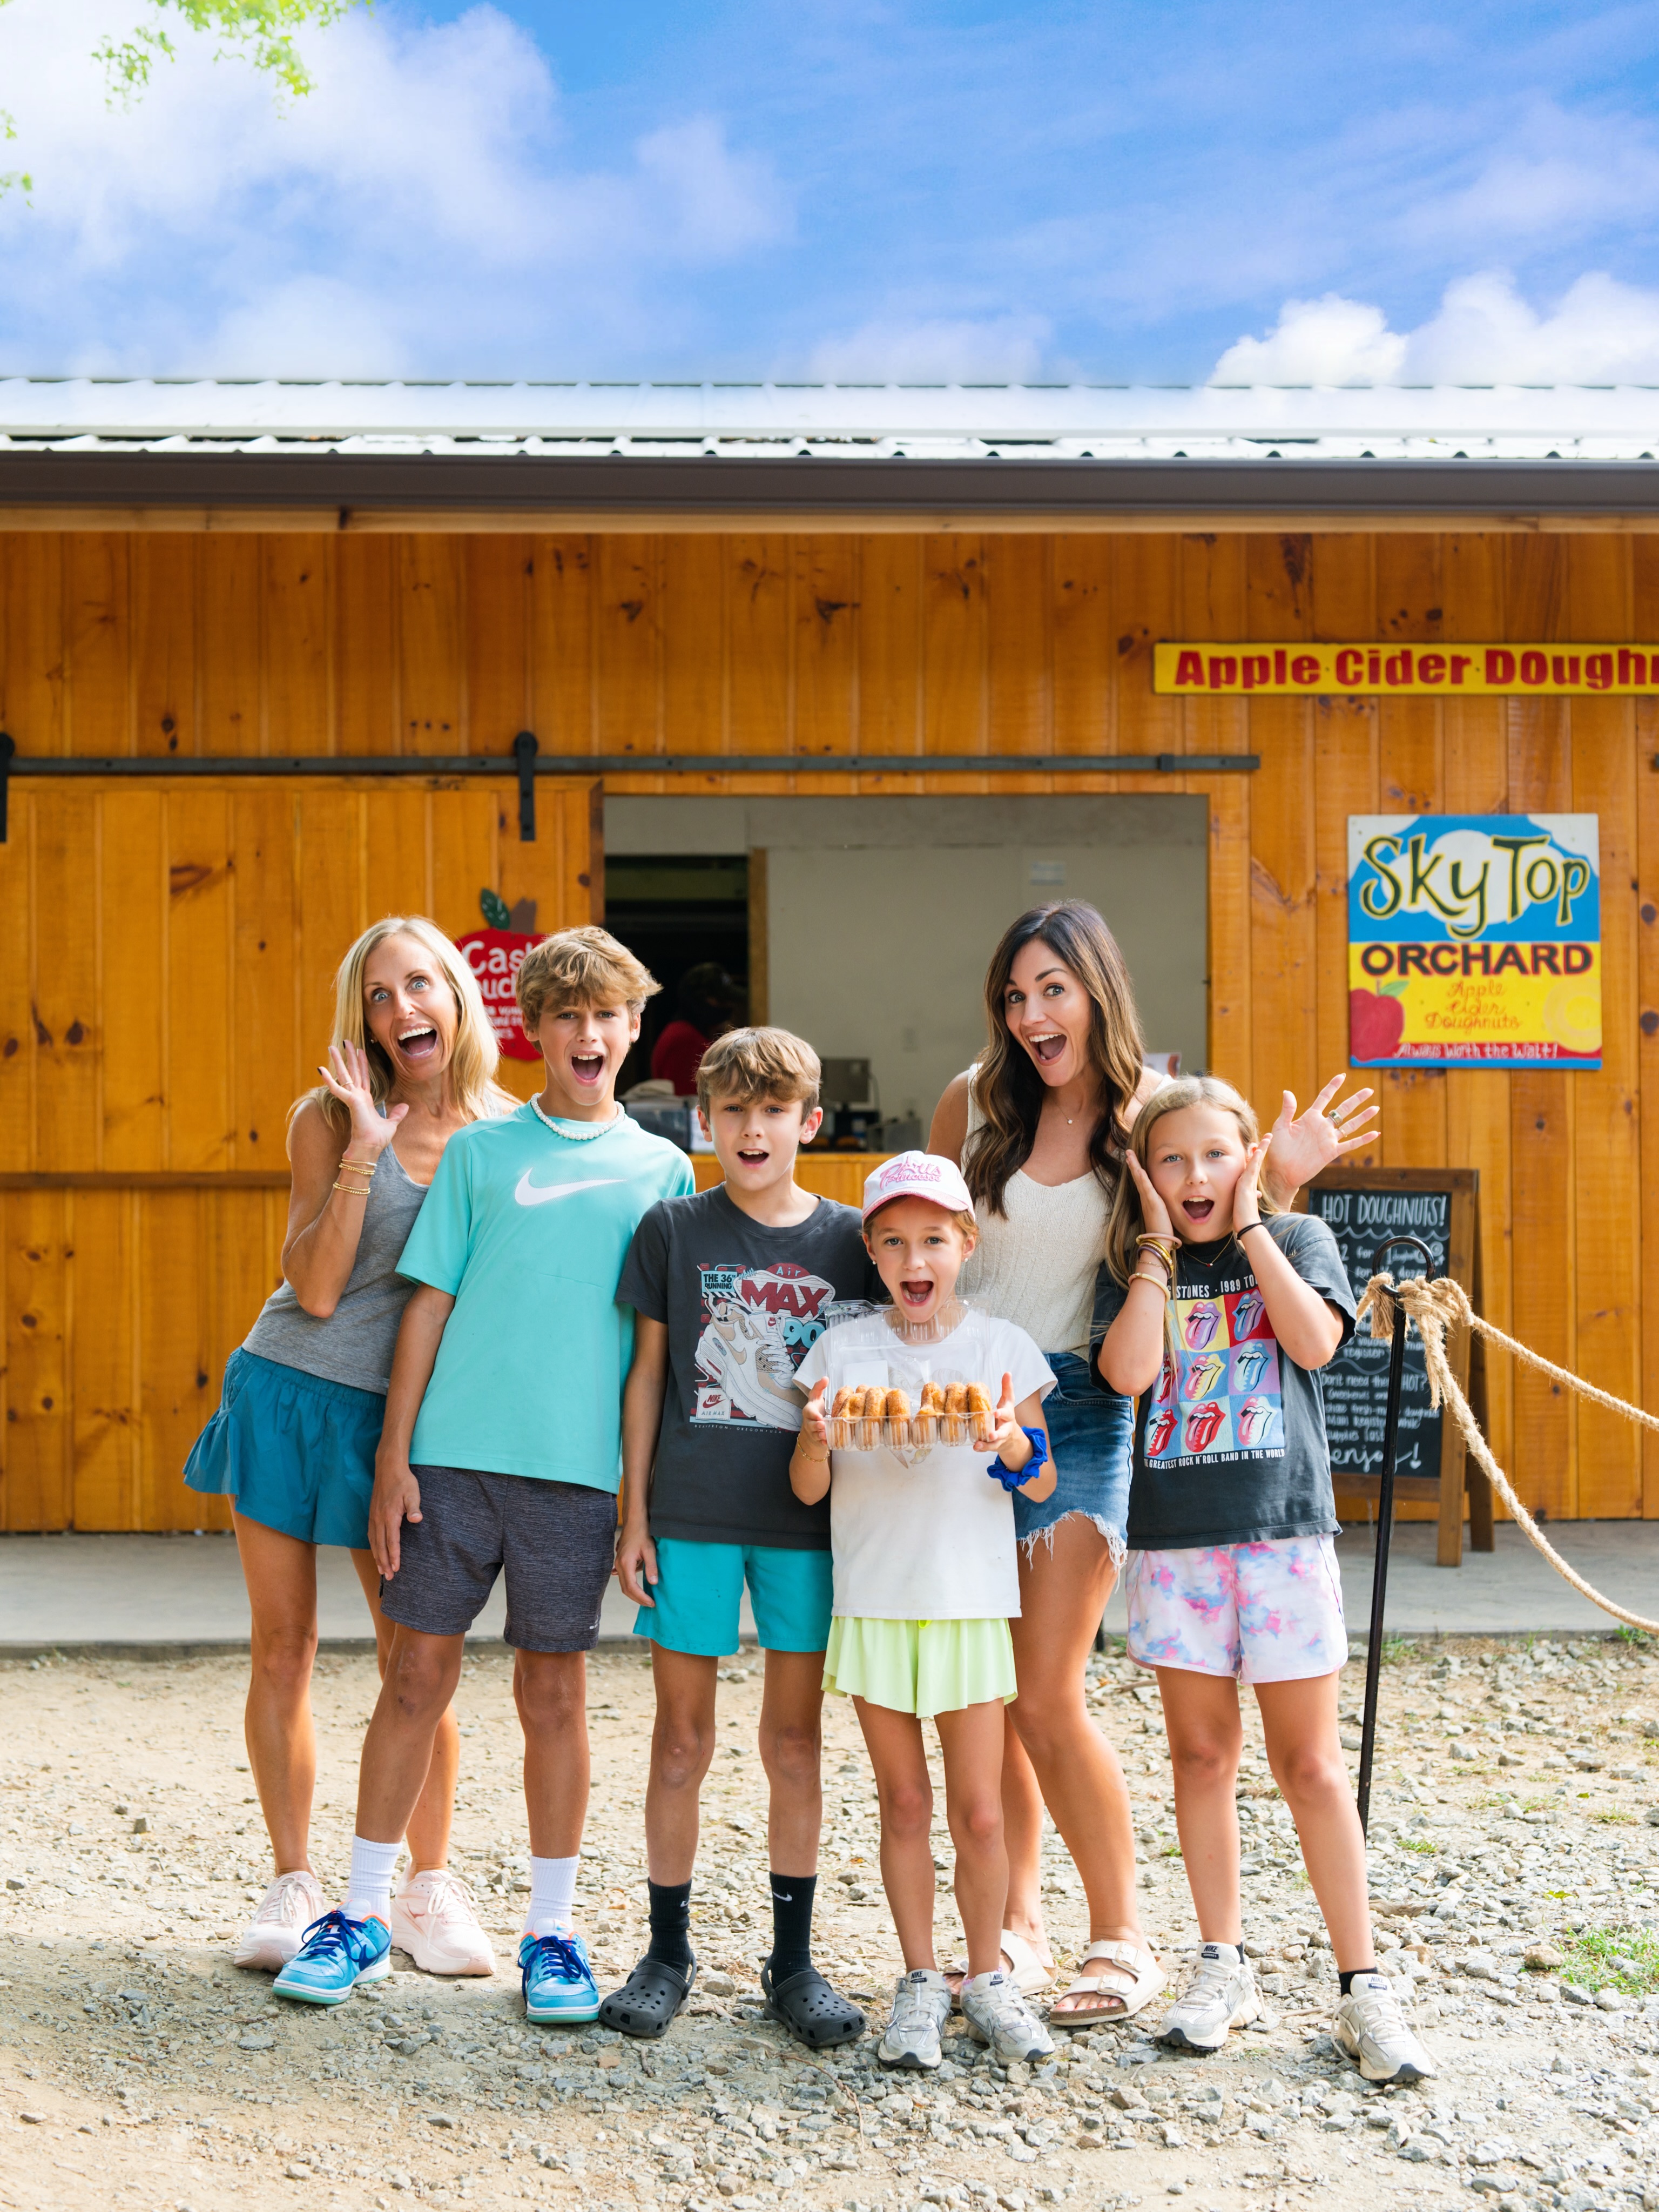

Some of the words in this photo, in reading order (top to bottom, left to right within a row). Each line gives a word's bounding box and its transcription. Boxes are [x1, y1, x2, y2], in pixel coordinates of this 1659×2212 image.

[1175, 649, 1321, 689] Apple
[1335, 649, 1472, 686] Cider
[1360, 833, 1491, 940] Sky
[1491, 834, 1590, 926] Top
[1361, 943, 1593, 976] ORCHARD
[1446, 979, 1507, 1003] Apple
[1484, 1043, 1509, 1059] the
[1323, 1194, 1352, 1224] HOT
[1357, 1195, 1447, 1227] DOUGHNUTS!
[704, 1274, 718, 1282] THE
[776, 1266, 801, 1277] Air
[741, 1280, 830, 1317] MAX
[1176, 1285, 1210, 1299] STONES
[1220, 1279, 1241, 1293] 1989
[783, 1317, 826, 1349] 90
[1149, 1458, 1177, 1469] GREATEST
[1178, 1456, 1194, 1467] ROCK
[1221, 1451, 1239, 1462] BAND
[1242, 1450, 1249, 1461] IN
[1251, 1450, 1264, 1460] THE
[1266, 1448, 1285, 1458] WORLD
[911, 1971, 922, 1979] NIKE
